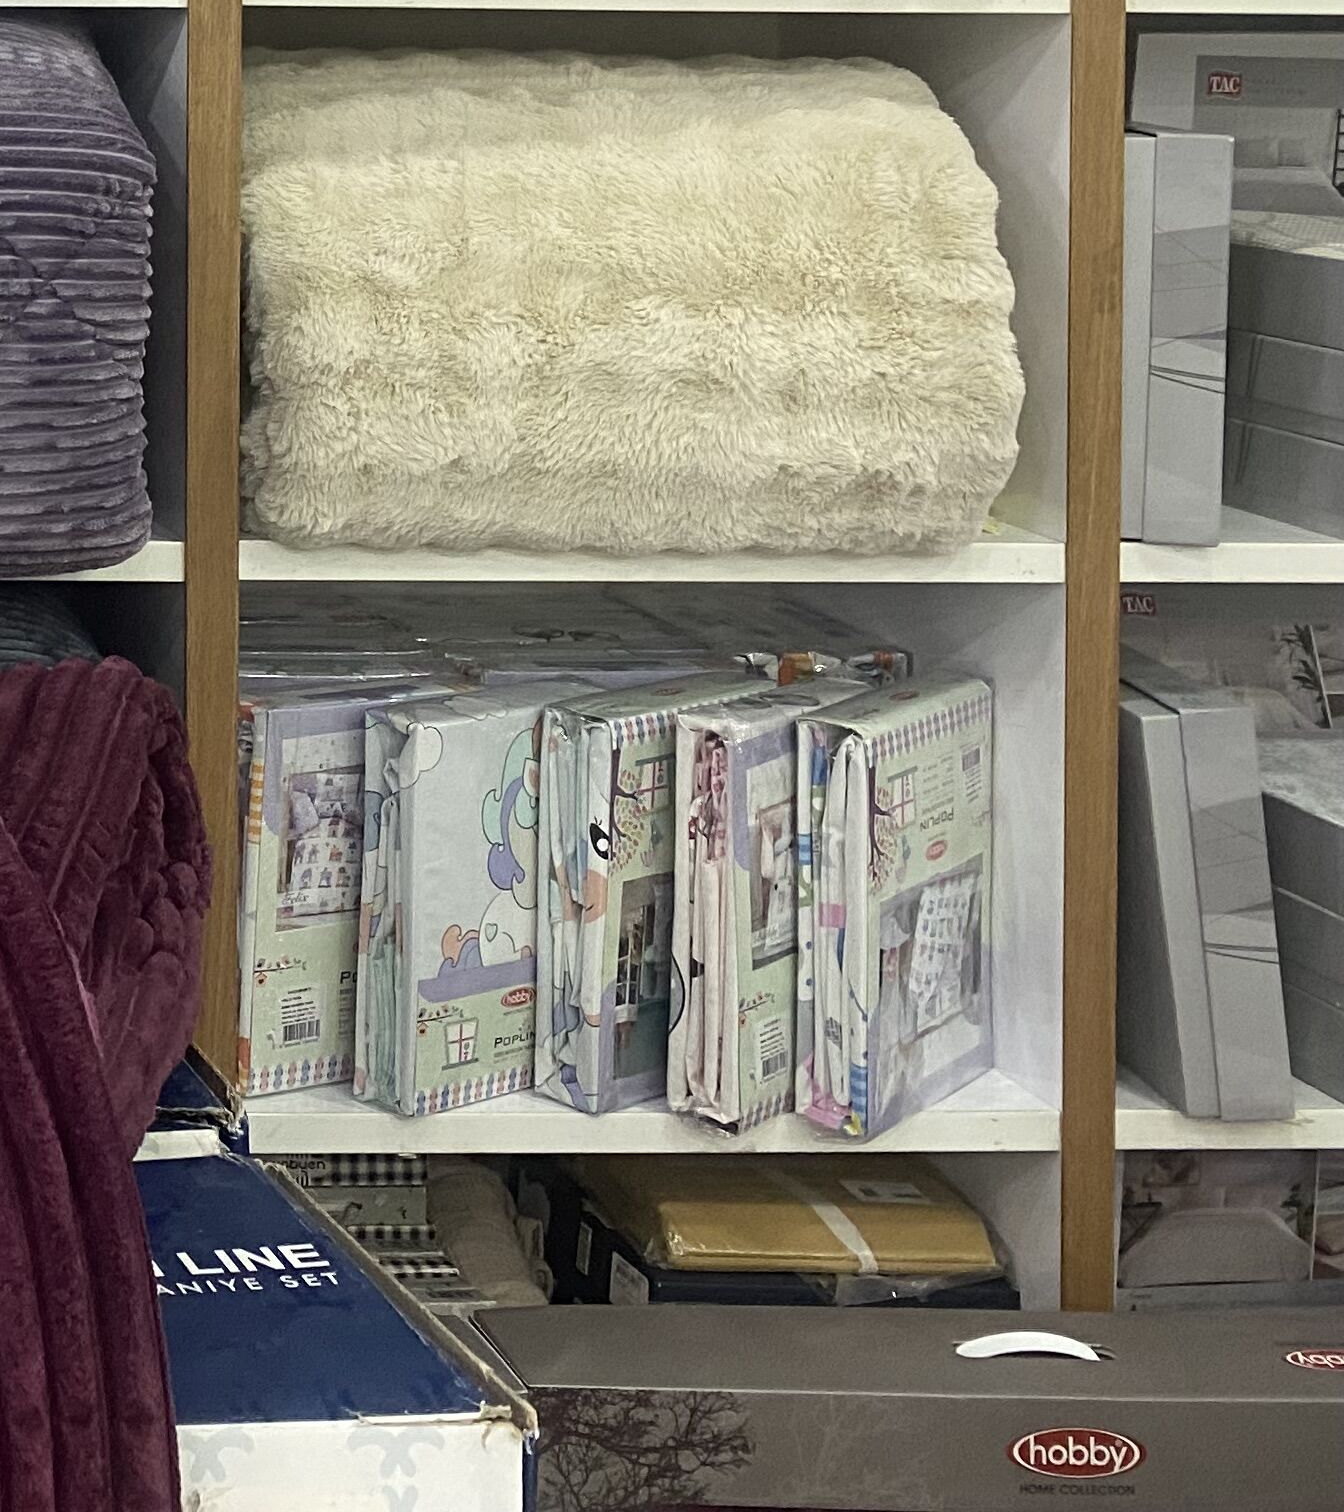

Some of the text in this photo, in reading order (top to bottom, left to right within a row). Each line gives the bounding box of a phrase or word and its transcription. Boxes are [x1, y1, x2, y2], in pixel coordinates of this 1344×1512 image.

[176, 1243, 331, 1275] LINE
[156, 1272, 339, 1296] ANIYE SET
[1029, 1436, 1128, 1474] hobby
